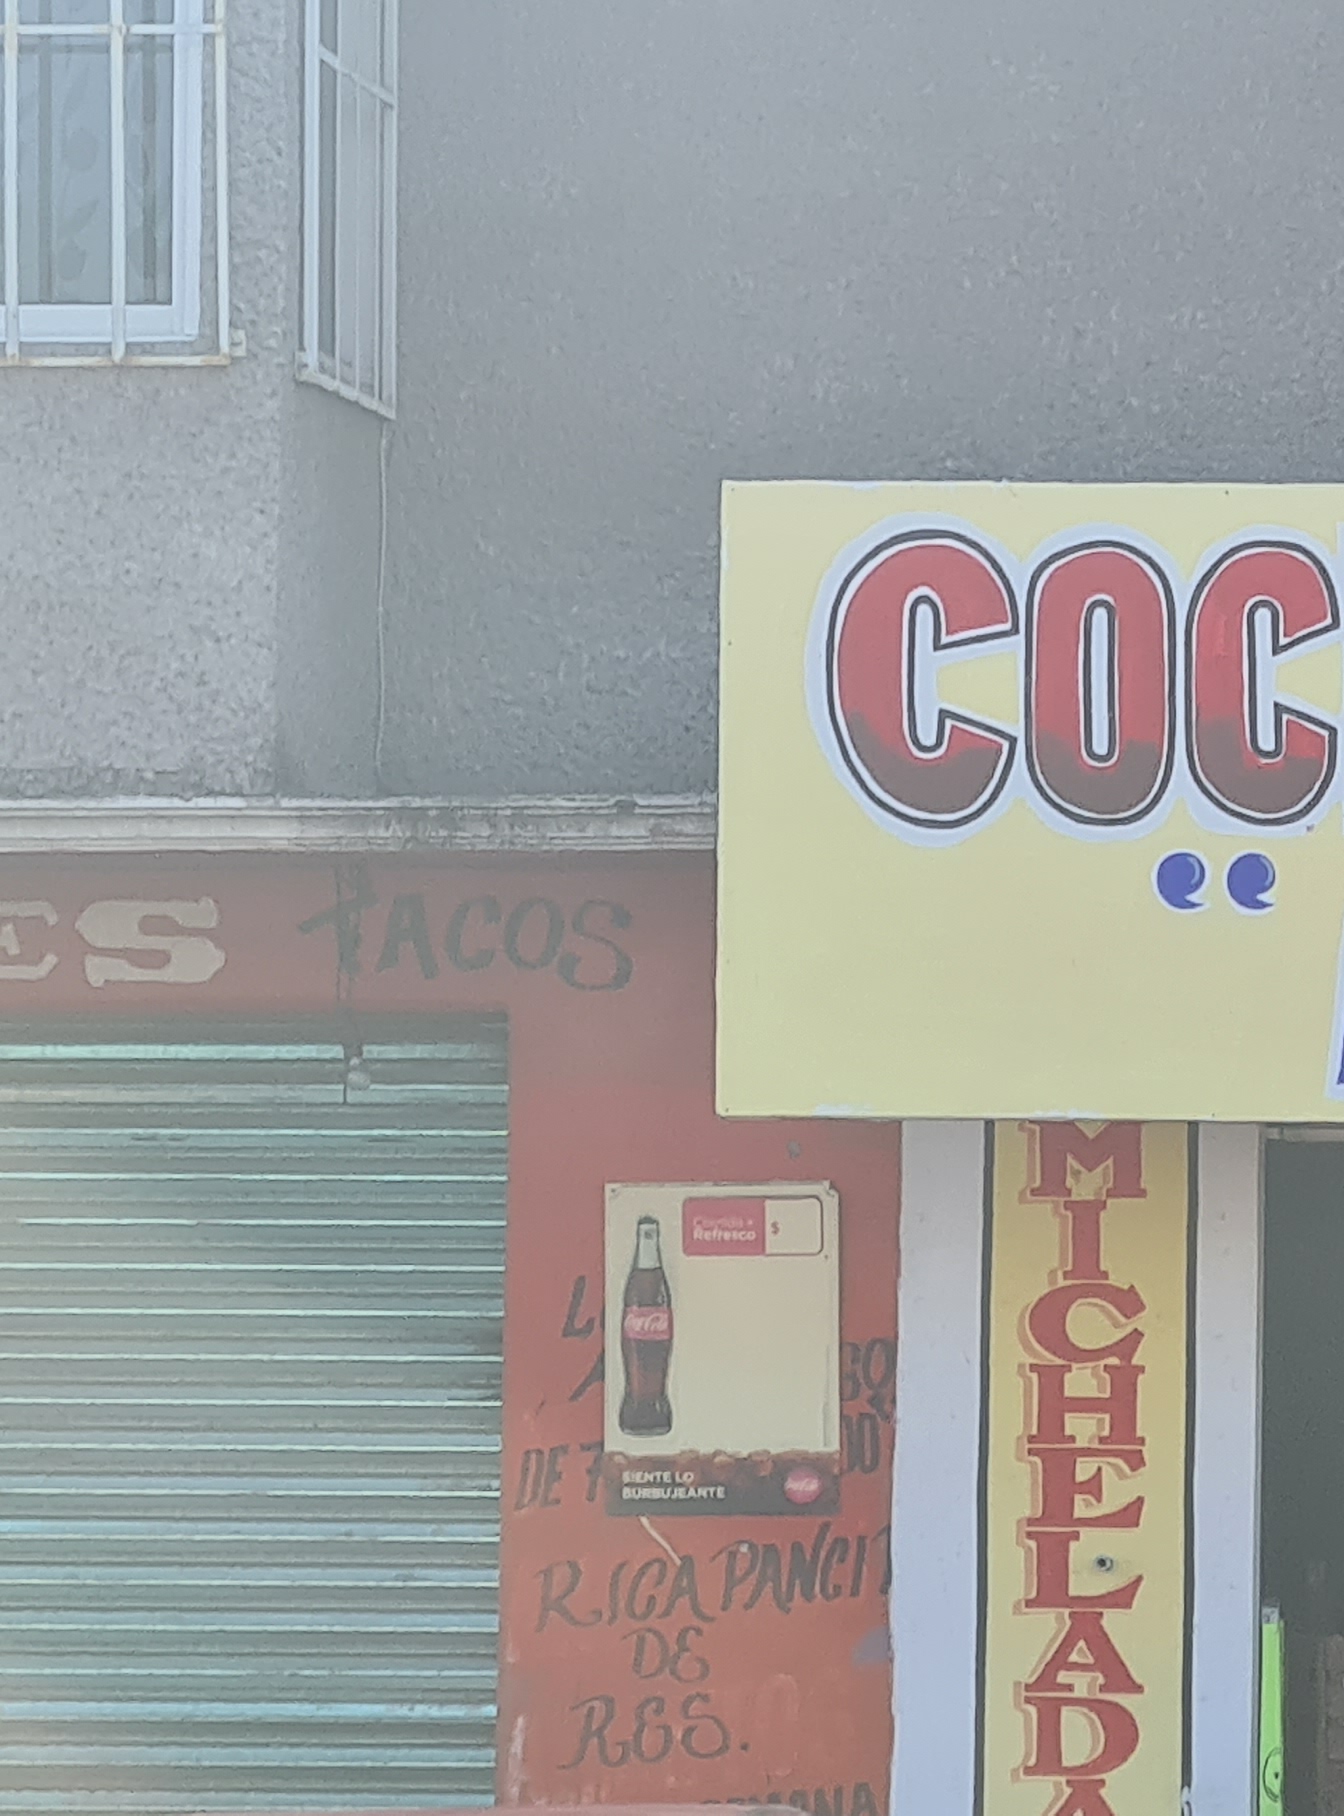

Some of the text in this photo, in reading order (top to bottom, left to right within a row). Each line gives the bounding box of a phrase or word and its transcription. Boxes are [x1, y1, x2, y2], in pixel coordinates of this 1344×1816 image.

[300, 876, 634, 992] TACOS
[692, 1225, 757, 1242] Refresco
[770, 1220, 781, 1236] $
[621, 1470, 695, 1484] SIENTE LO
[621, 1485, 726, 1501] BURBUJEANTE
[535, 1554, 716, 1634] RICA
[621, 1625, 711, 1684] DE
